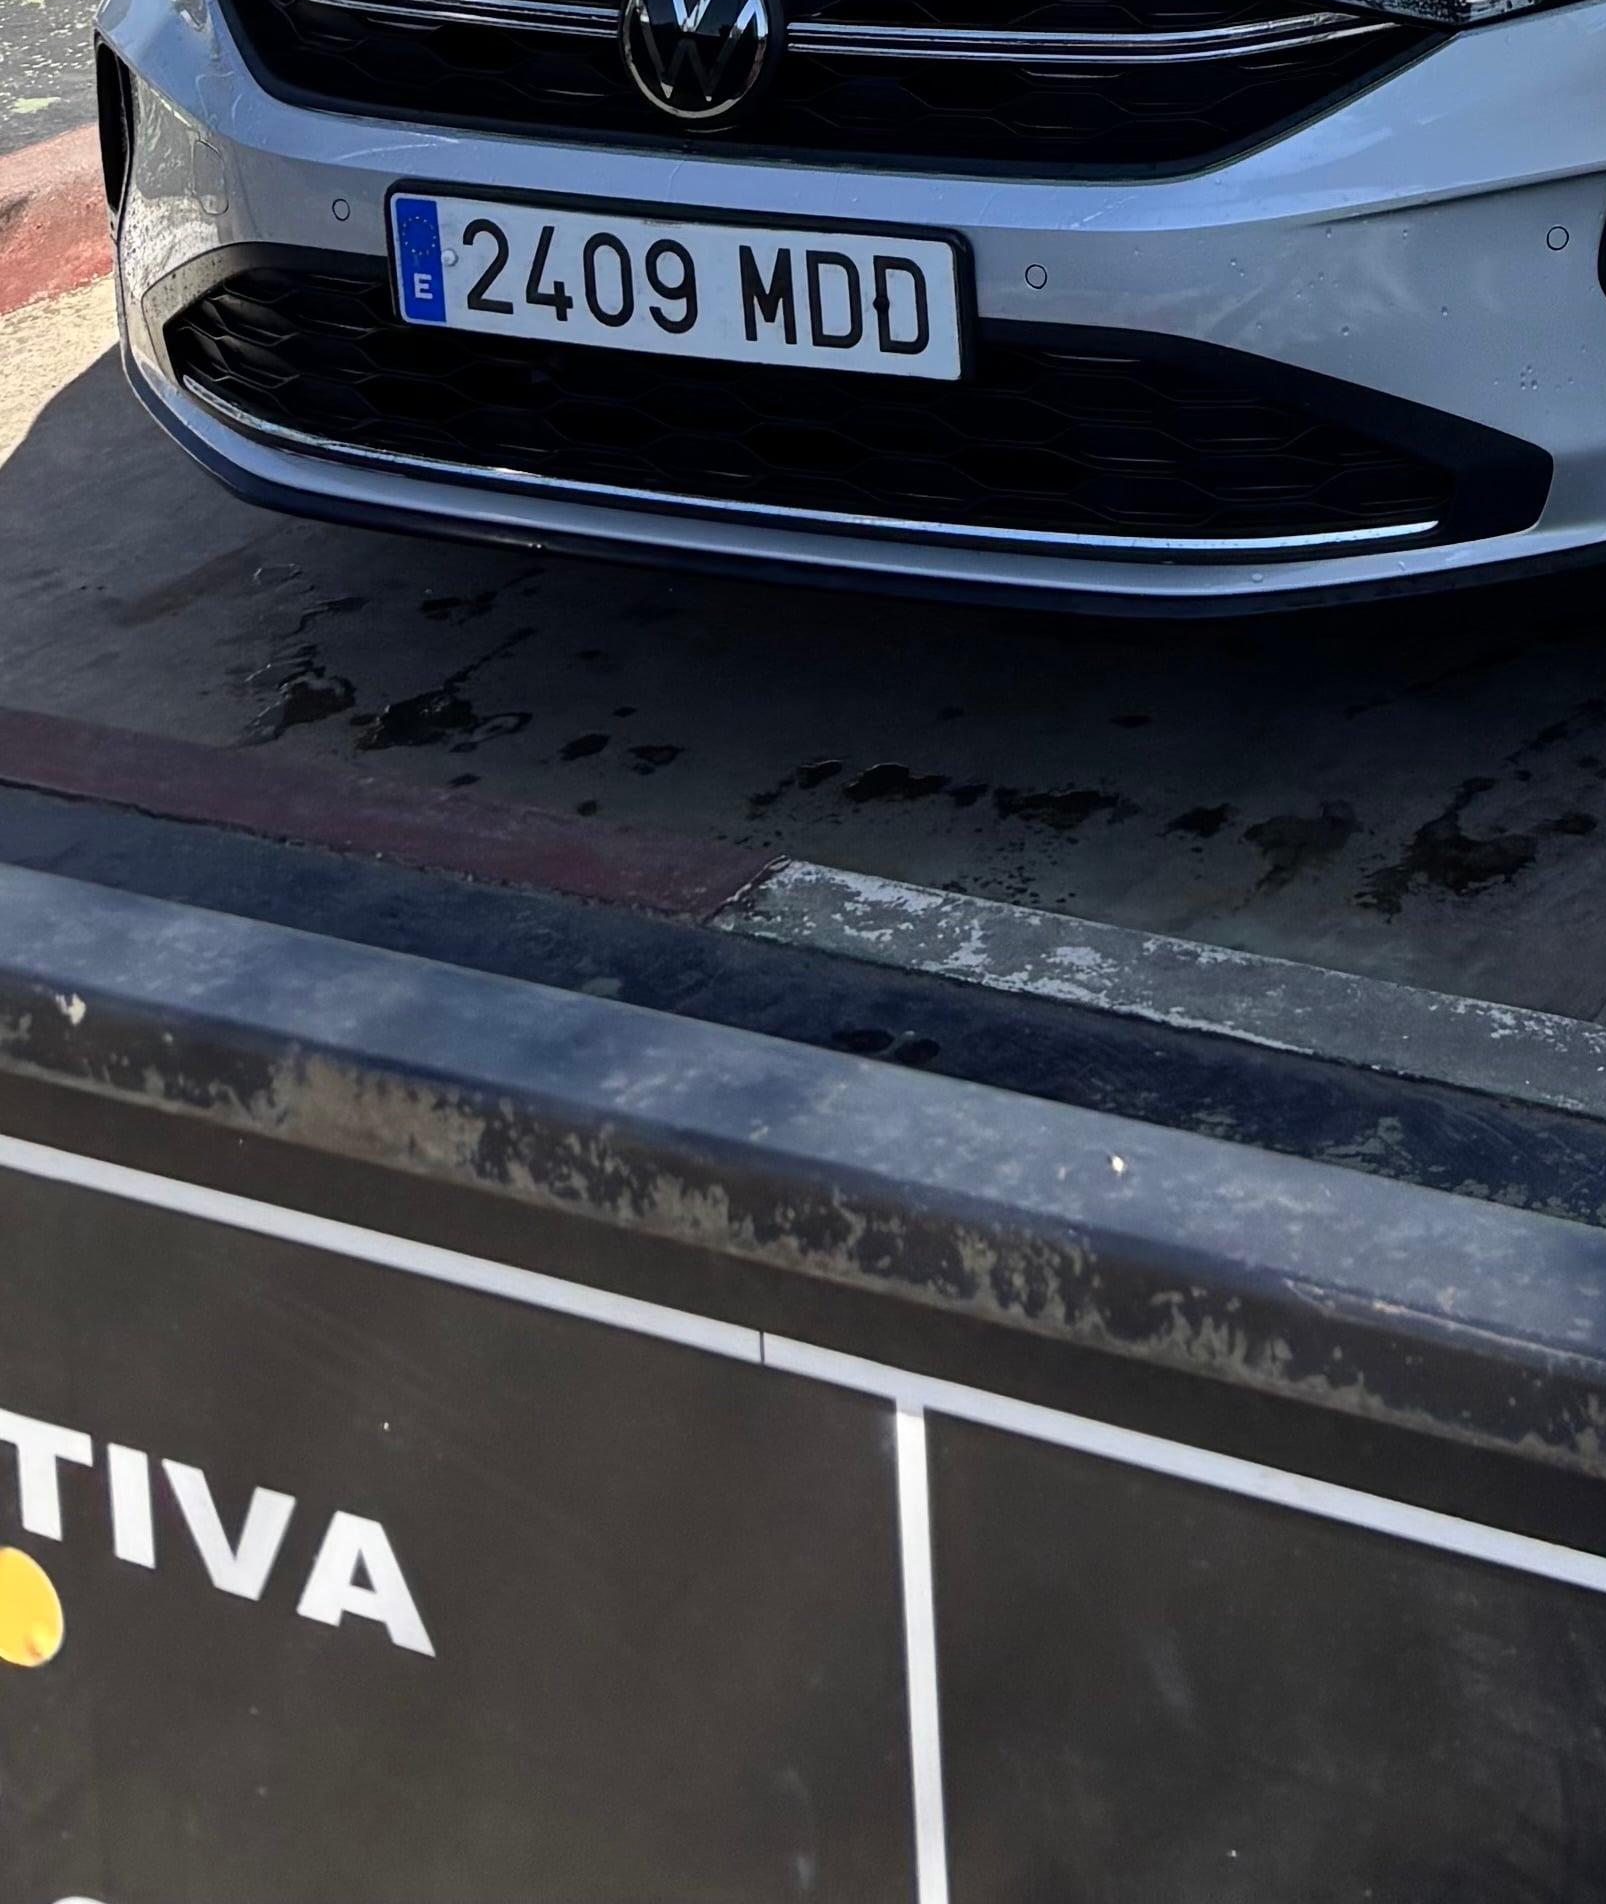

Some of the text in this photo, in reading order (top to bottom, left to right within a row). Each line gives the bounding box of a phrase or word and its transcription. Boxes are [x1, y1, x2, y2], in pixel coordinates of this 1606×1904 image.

[414, 273, 433, 300] E
[462, 219, 930, 355] 2409 MDD
[0, 1408, 437, 1658] TIVA
